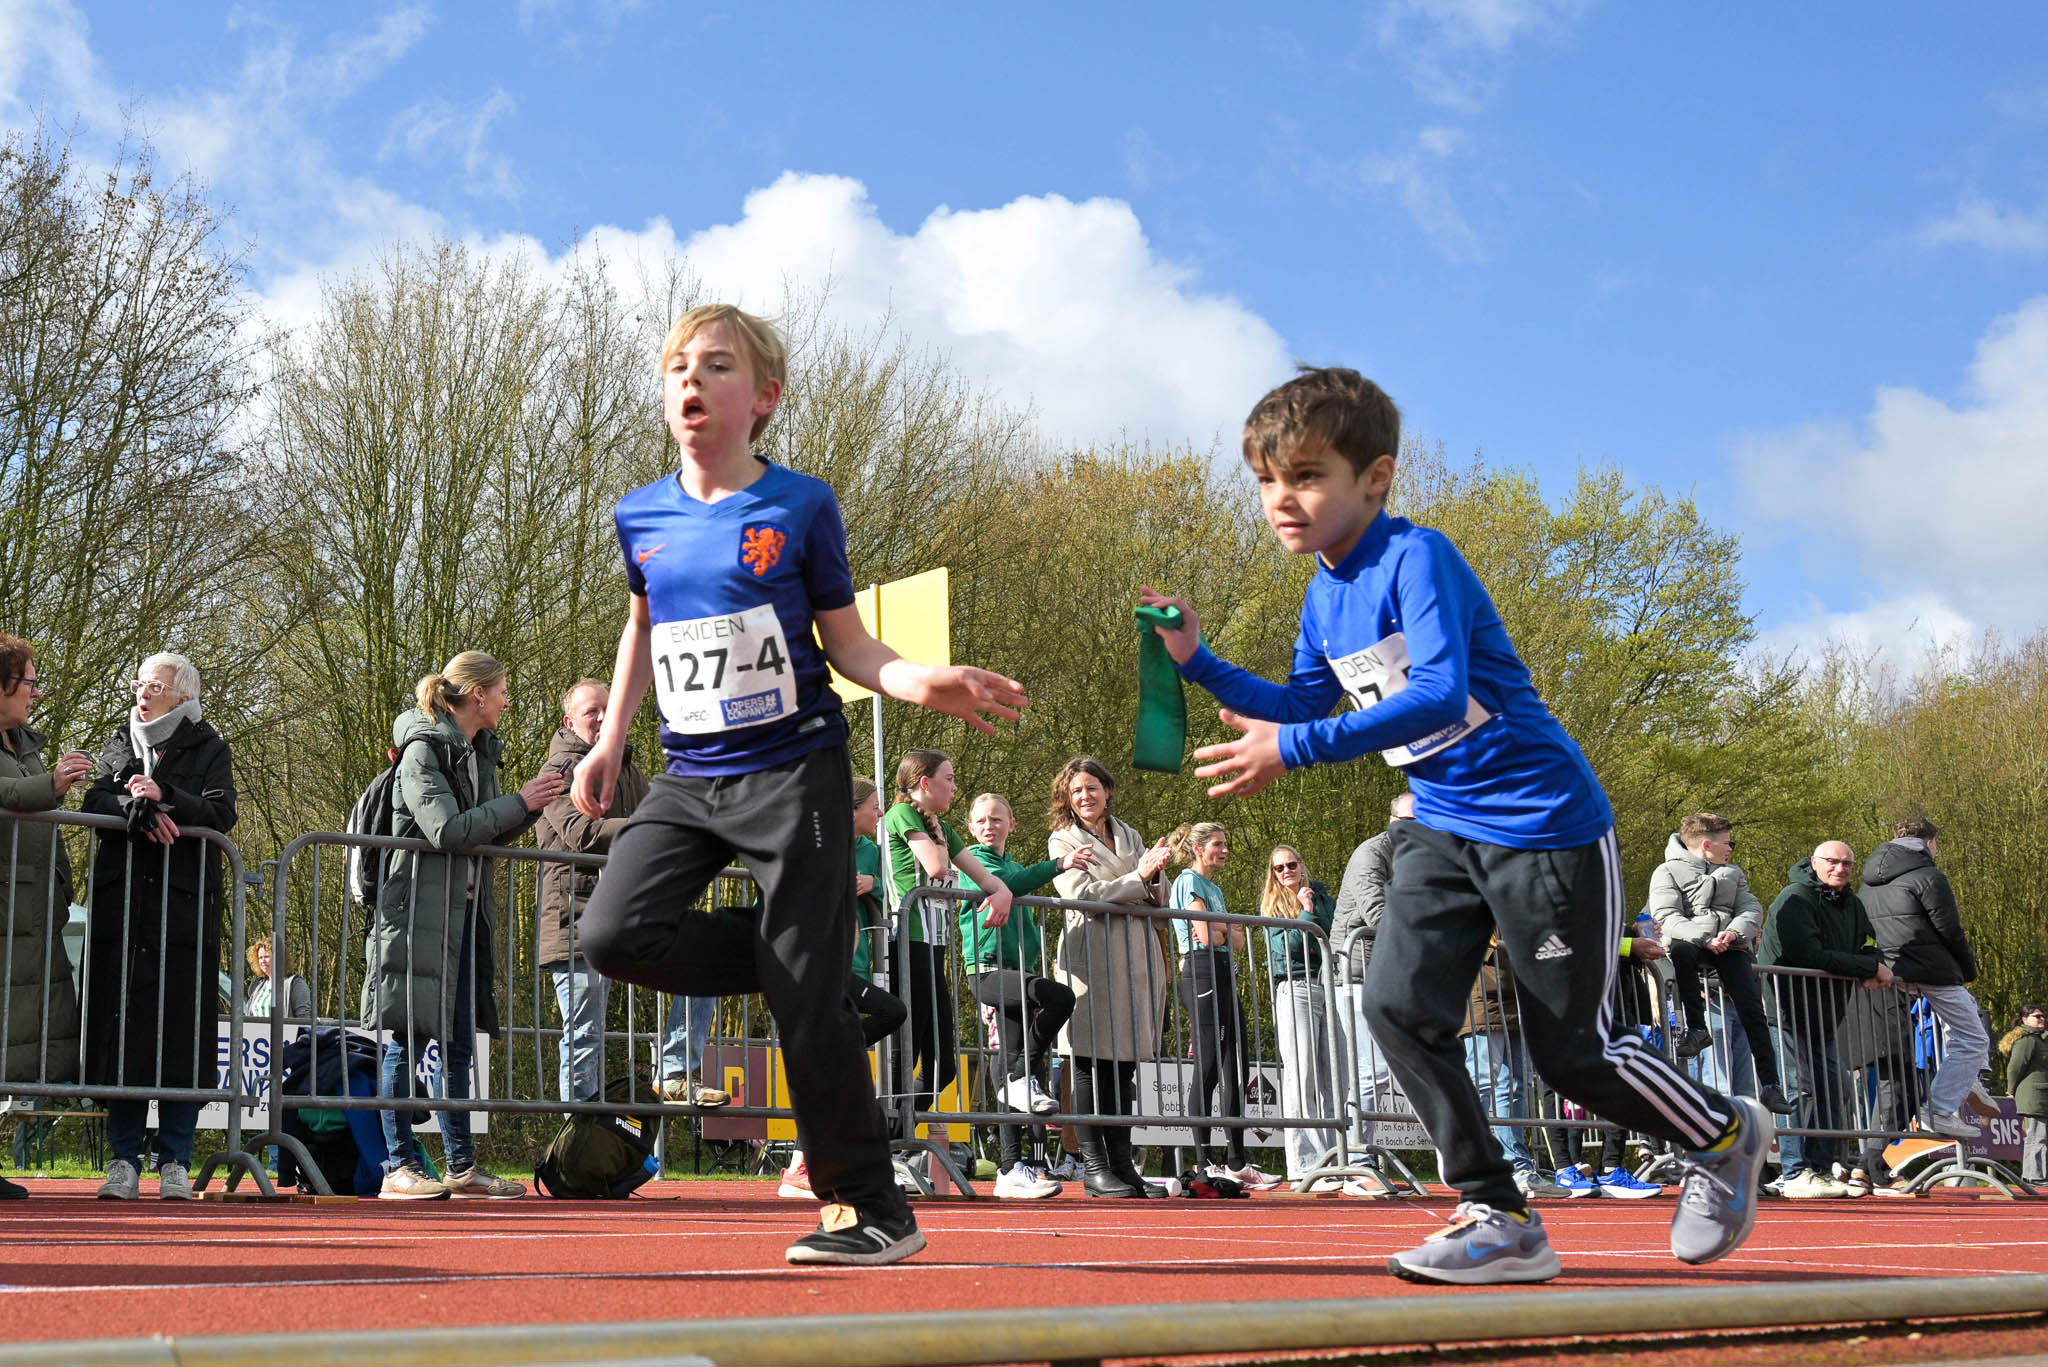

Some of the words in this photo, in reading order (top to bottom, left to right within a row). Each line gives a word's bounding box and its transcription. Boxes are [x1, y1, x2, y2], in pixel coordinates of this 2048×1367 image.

[671, 616, 745, 643] EKIDEN
[658, 635, 786, 692] 127-4
[725, 697, 764, 712] LOPERS
[727, 704, 767, 720] COMPANY
[1535, 947, 1573, 960] adidas
[615, 1116, 641, 1138] PUMA
[1990, 1118, 2020, 1145] SNS
